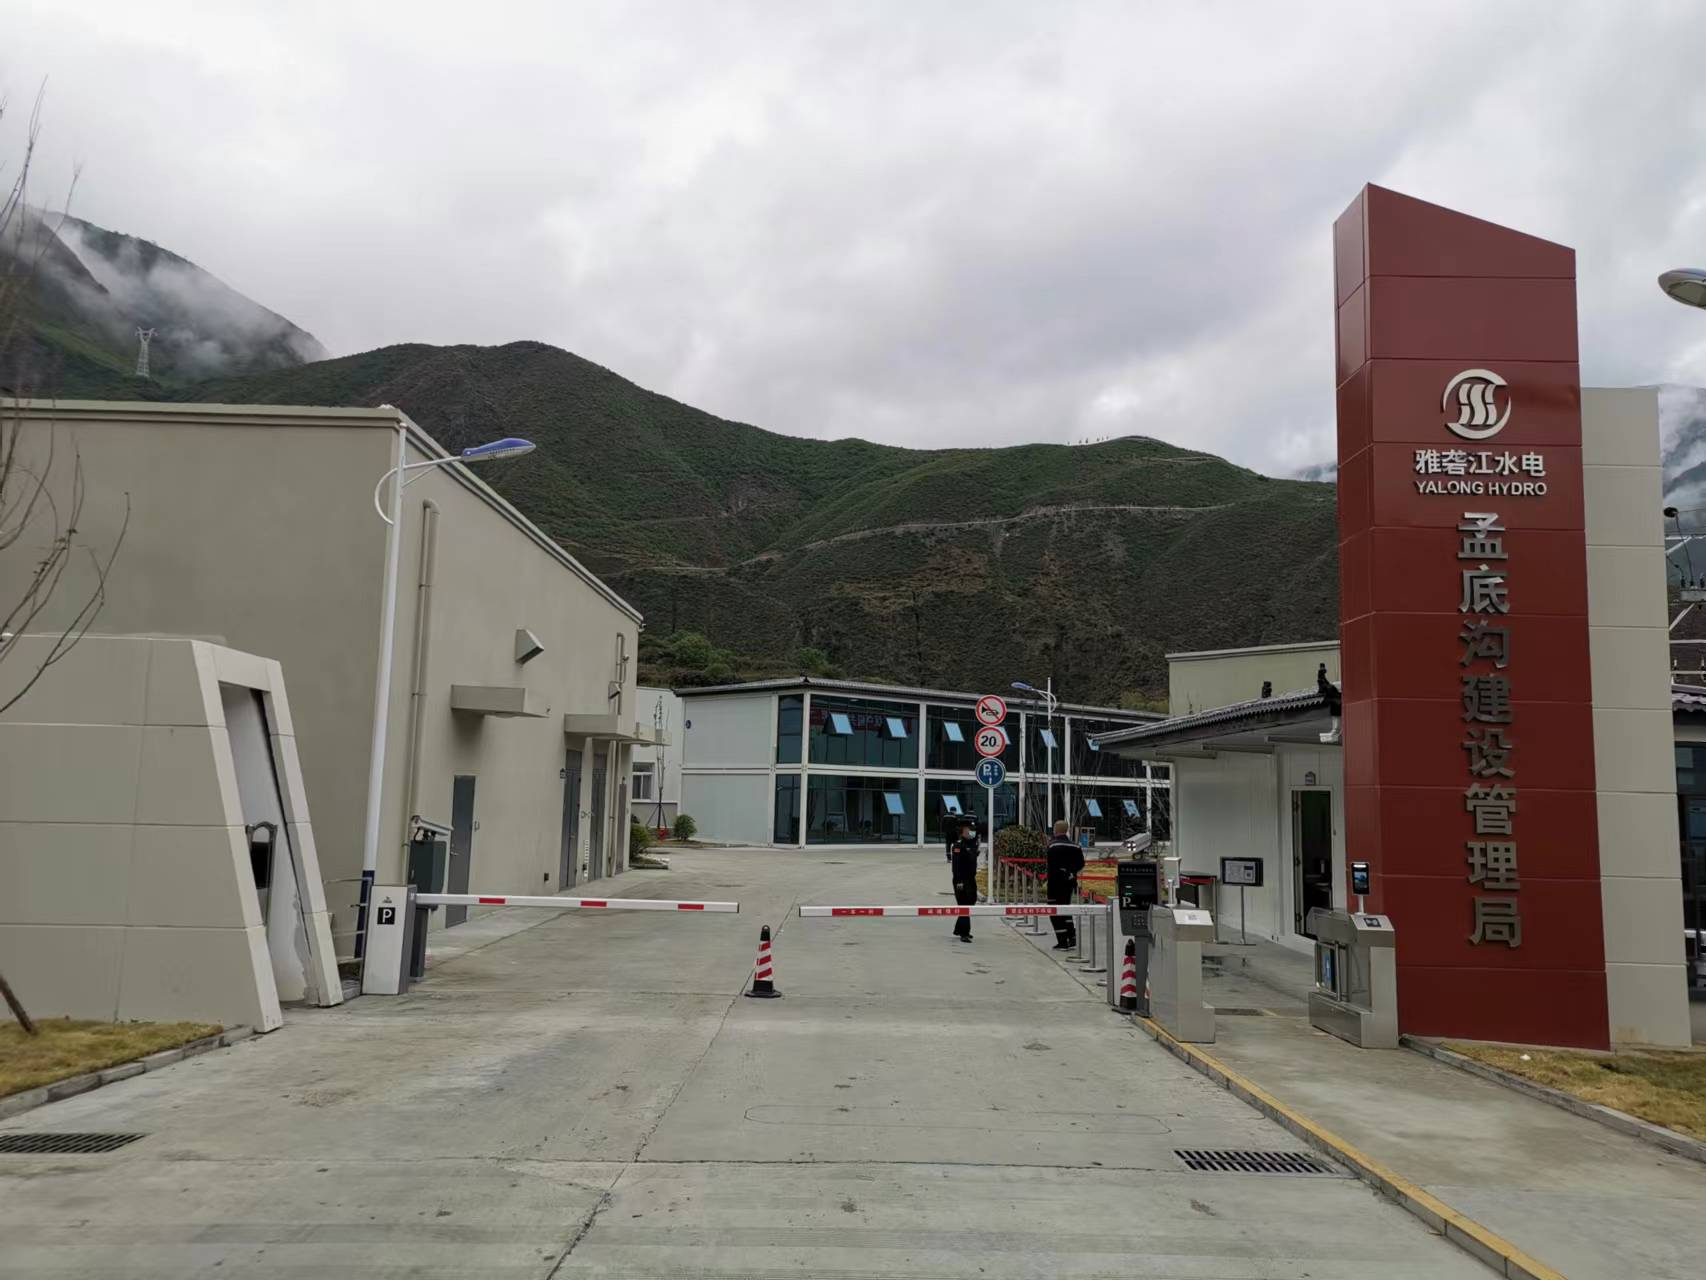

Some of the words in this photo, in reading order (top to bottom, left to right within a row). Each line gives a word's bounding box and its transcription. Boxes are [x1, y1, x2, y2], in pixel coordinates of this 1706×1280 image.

[1415, 449, 1546, 477] 雅砻江水电
[1415, 481, 1483, 495] YALONG
[1488, 481, 1547, 496] HYDRO
[1456, 511, 1522, 948] 孟底沟建设管理局
[980, 735, 997, 747] 20
[382, 909, 392, 923] P
